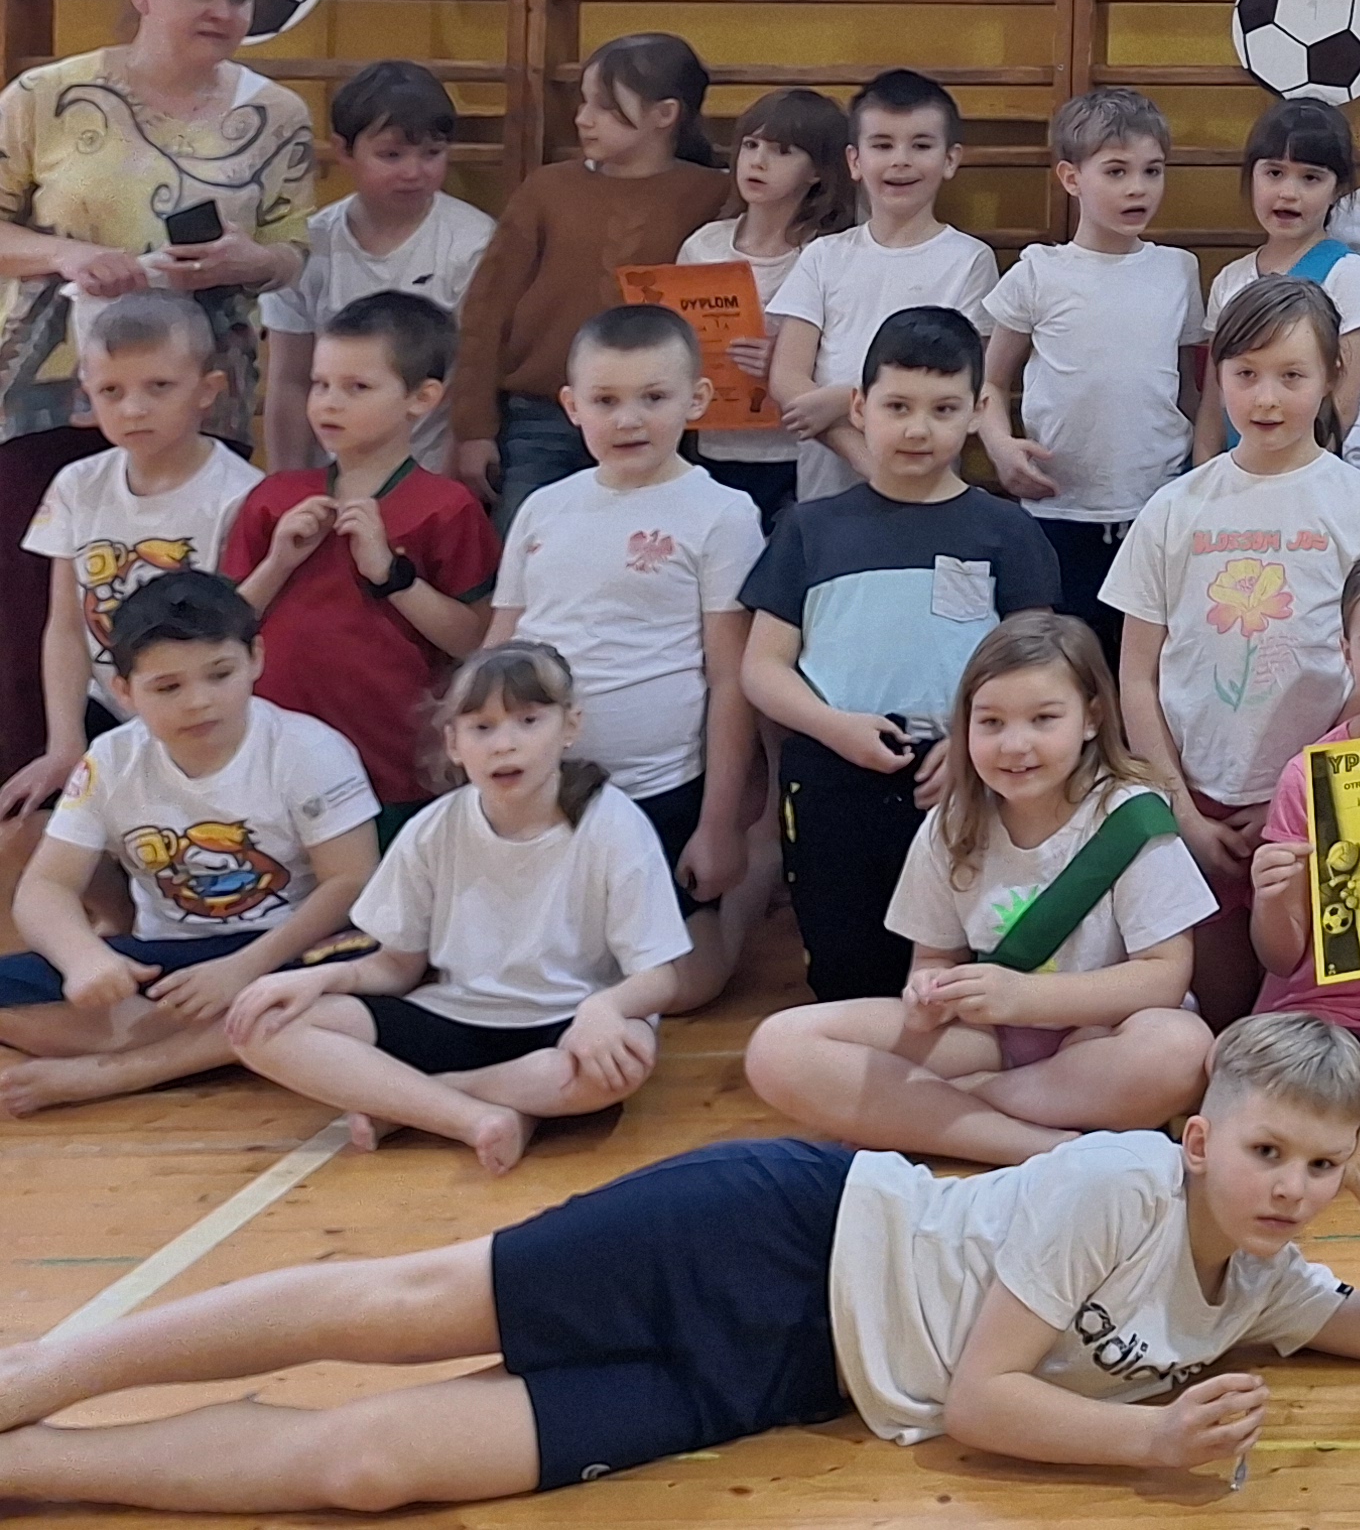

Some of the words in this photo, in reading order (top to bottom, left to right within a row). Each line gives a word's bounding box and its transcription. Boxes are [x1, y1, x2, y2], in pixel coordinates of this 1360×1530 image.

[680, 295, 739, 311] DYPLOM
[1192, 529, 1282, 556] BLOSSOM
[1286, 529, 1329, 552] JOY
